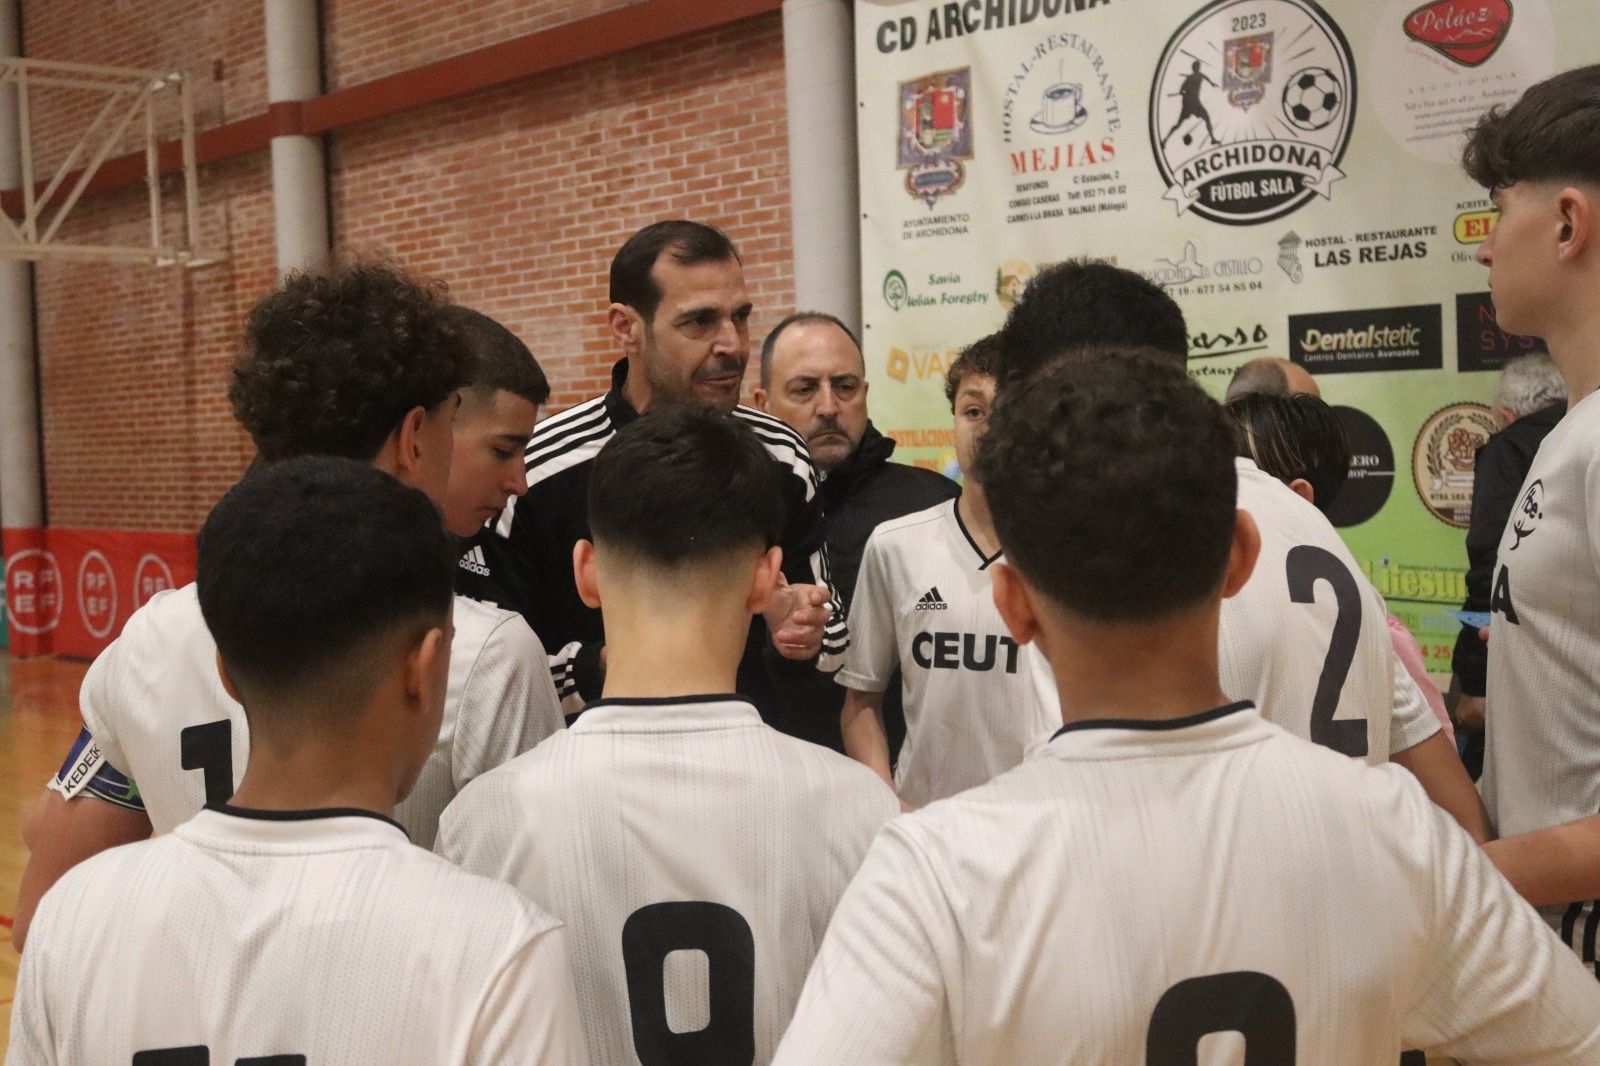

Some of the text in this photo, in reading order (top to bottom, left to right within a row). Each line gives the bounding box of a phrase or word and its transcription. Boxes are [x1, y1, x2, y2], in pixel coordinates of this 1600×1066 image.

[1232, 13, 1267, 32] 2023
[876, 17, 917, 53] CD
[1010, 137, 1116, 174] MEJIAS
[1181, 144, 1323, 186] ARCHIDONA
[1210, 177, 1295, 202] FÚTBOL SALA
[903, 213, 969, 227] AYUNTAMIENTO
[915, 226, 969, 237] ARCHIDONA
[1305, 237, 1346, 247] HOSTAL
[1355, 225, 1437, 242] RESTAURANTE
[1313, 242, 1428, 267] LAS REJAS
[1301, 323, 1421, 351] Dentalstetic
[1304, 351, 1334, 362] Centros
[1336, 351, 1375, 361] Dentales
[459, 559, 490, 577] adidas
[915, 600, 948, 611] adidas
[1286, 545, 1368, 758] 2
